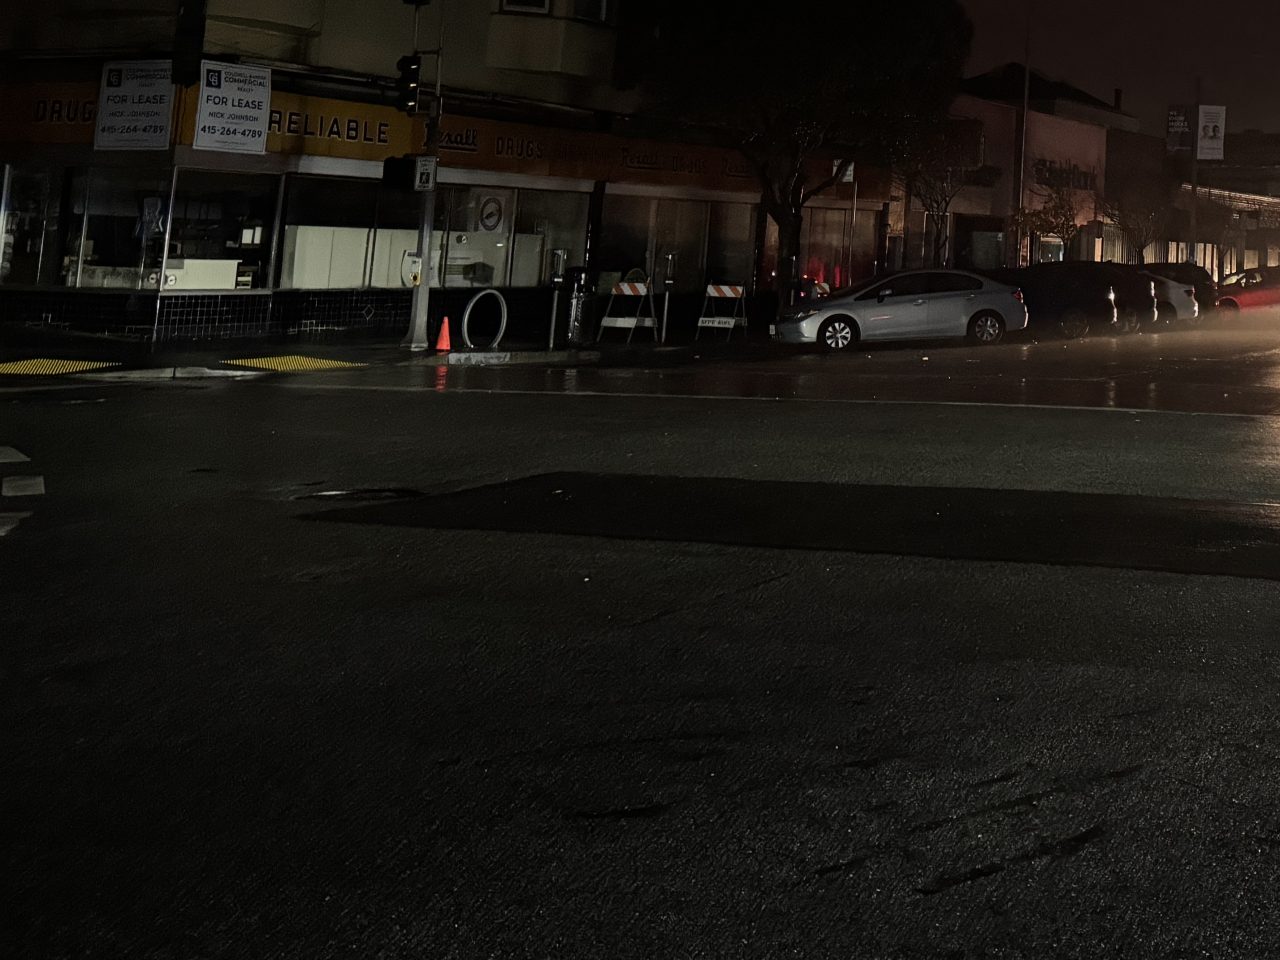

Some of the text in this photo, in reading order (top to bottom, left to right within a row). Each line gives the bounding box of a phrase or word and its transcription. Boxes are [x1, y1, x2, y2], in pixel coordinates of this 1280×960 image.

[224, 76, 266, 87] COMMERCIAL
[106, 95, 167, 104] FOR LEASE
[206, 95, 264, 110] FOR LEASE
[226, 113, 259, 122] JOHNSON
[200, 125, 263, 139] 415-264-4789
[268, 109, 390, 144] RELIABLE
[495, 136, 545, 159] DRUGS
